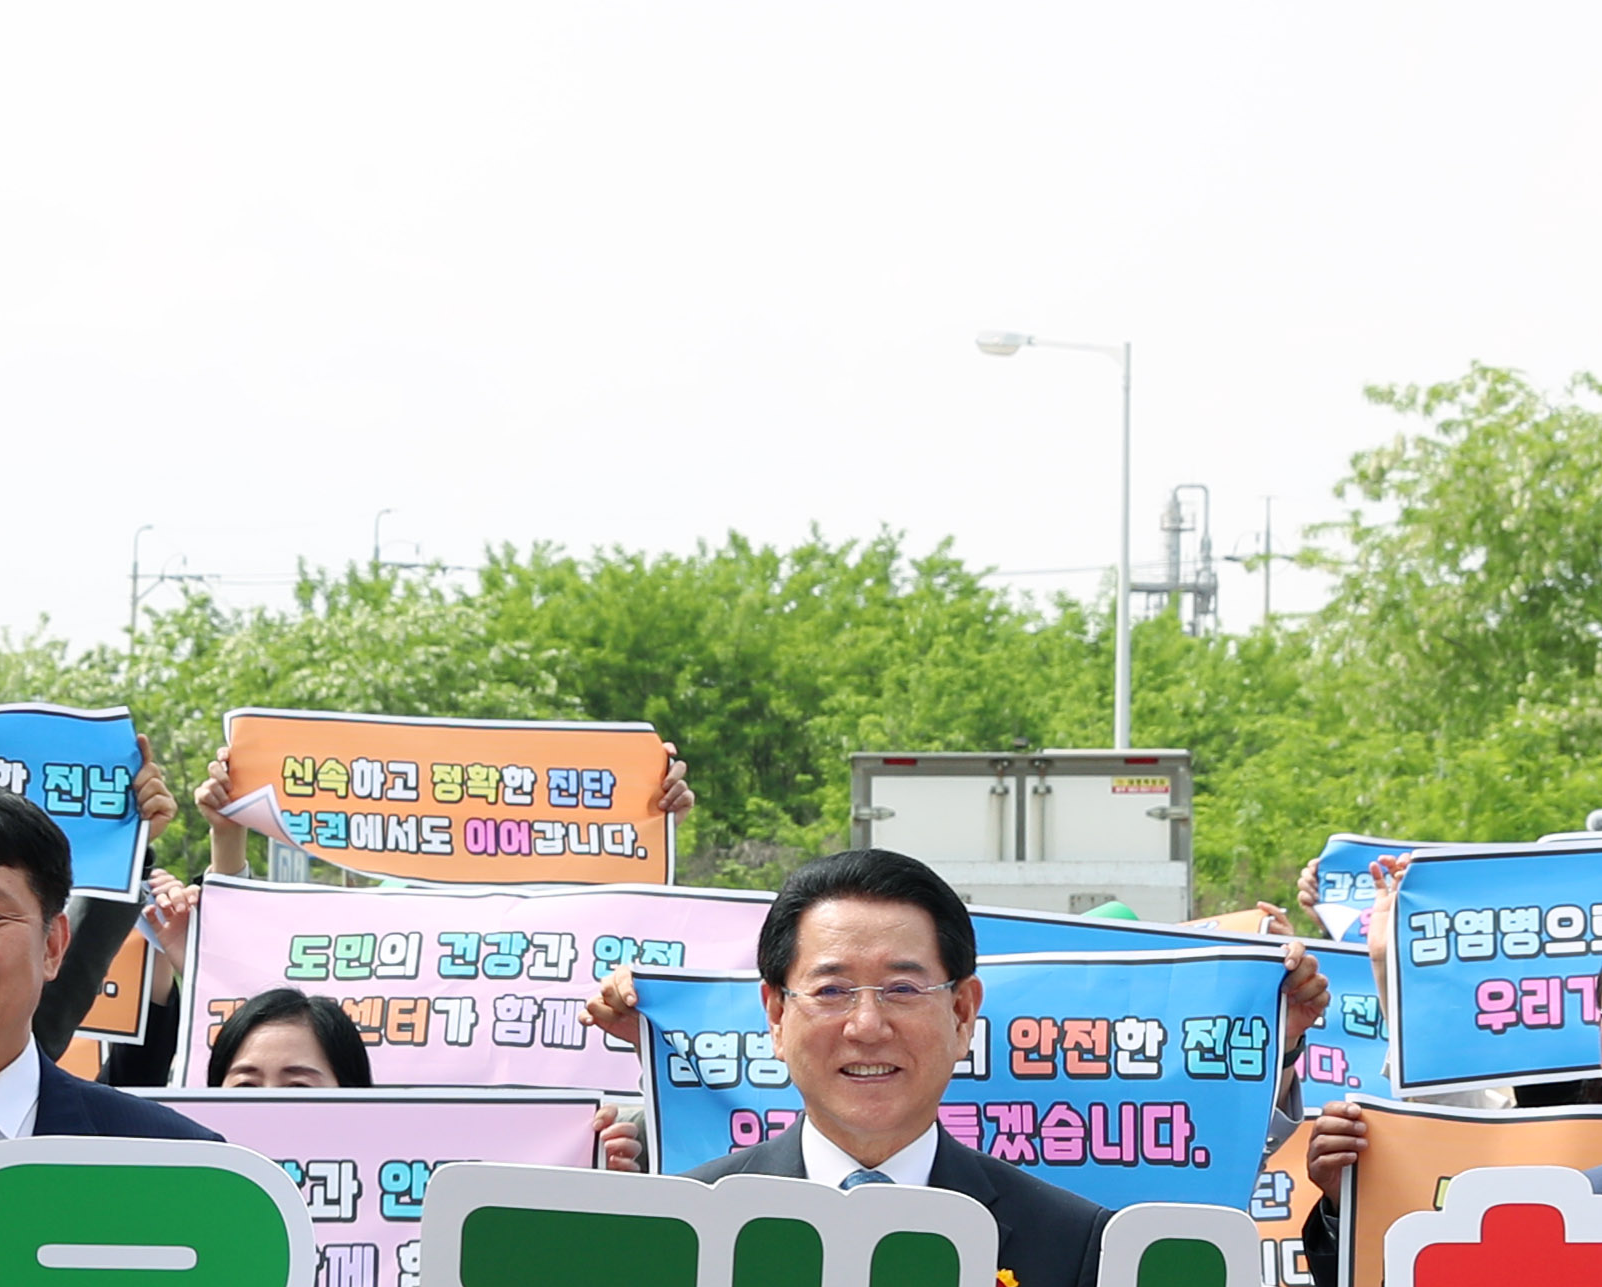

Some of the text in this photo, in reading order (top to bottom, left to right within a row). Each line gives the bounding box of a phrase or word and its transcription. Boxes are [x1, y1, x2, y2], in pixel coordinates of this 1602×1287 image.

[42, 763, 135, 820] 전남
[281, 756, 616, 809] 신속하고 정확한 진단
[464, 818, 648, 860] 이어갑니다.
[284, 932, 423, 980] 도민의
[436, 931, 578, 981] 건강과
[492, 994, 588, 1049] 함께
[1341, 994, 1389, 1041] 전
[1008, 1016, 1169, 1083] 안전한
[1182, 1014, 1269, 1083] 전남
[1294, 1044, 1361, 1088] 다.
[271, 1159, 363, 1222] 과
